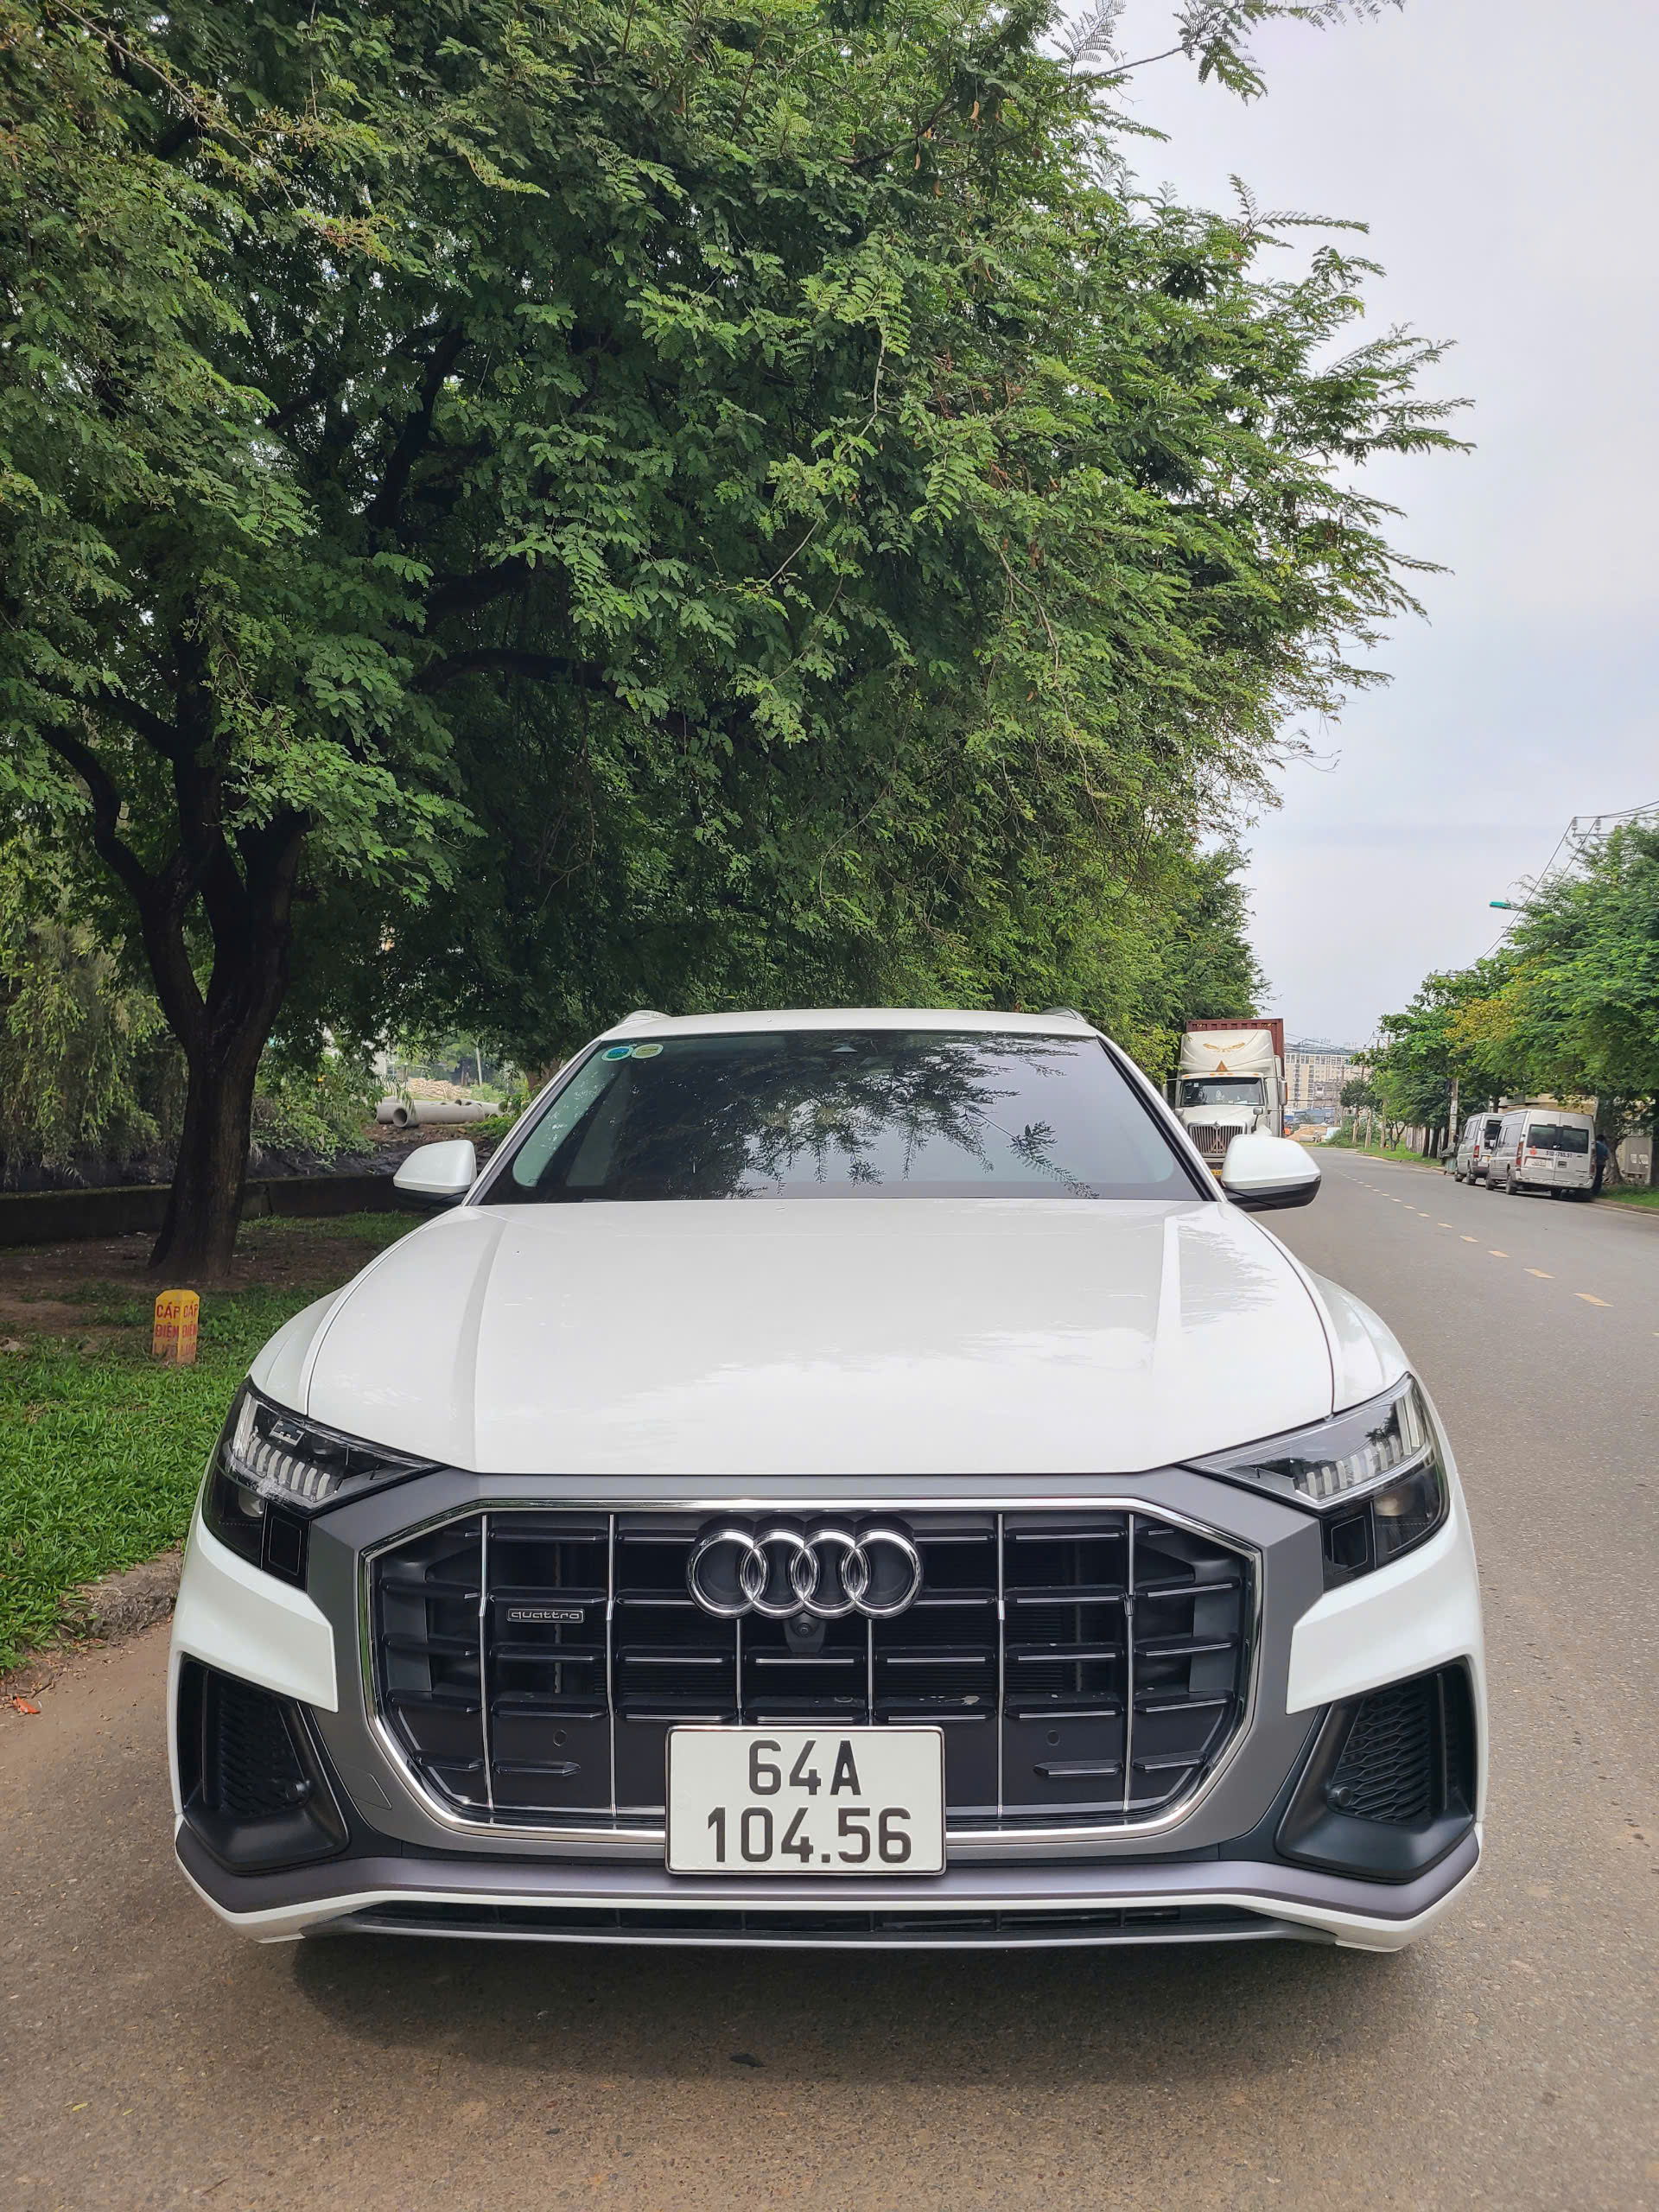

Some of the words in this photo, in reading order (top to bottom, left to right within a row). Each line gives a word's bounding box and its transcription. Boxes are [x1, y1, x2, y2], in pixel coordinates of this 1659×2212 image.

[156, 1301, 181, 1319] CÁP
[183, 1300, 199, 1318] CÁP
[511, 1611, 580, 1620] quattro
[748, 1739, 861, 1796] 64A
[707, 1806, 912, 1864] 104.56
